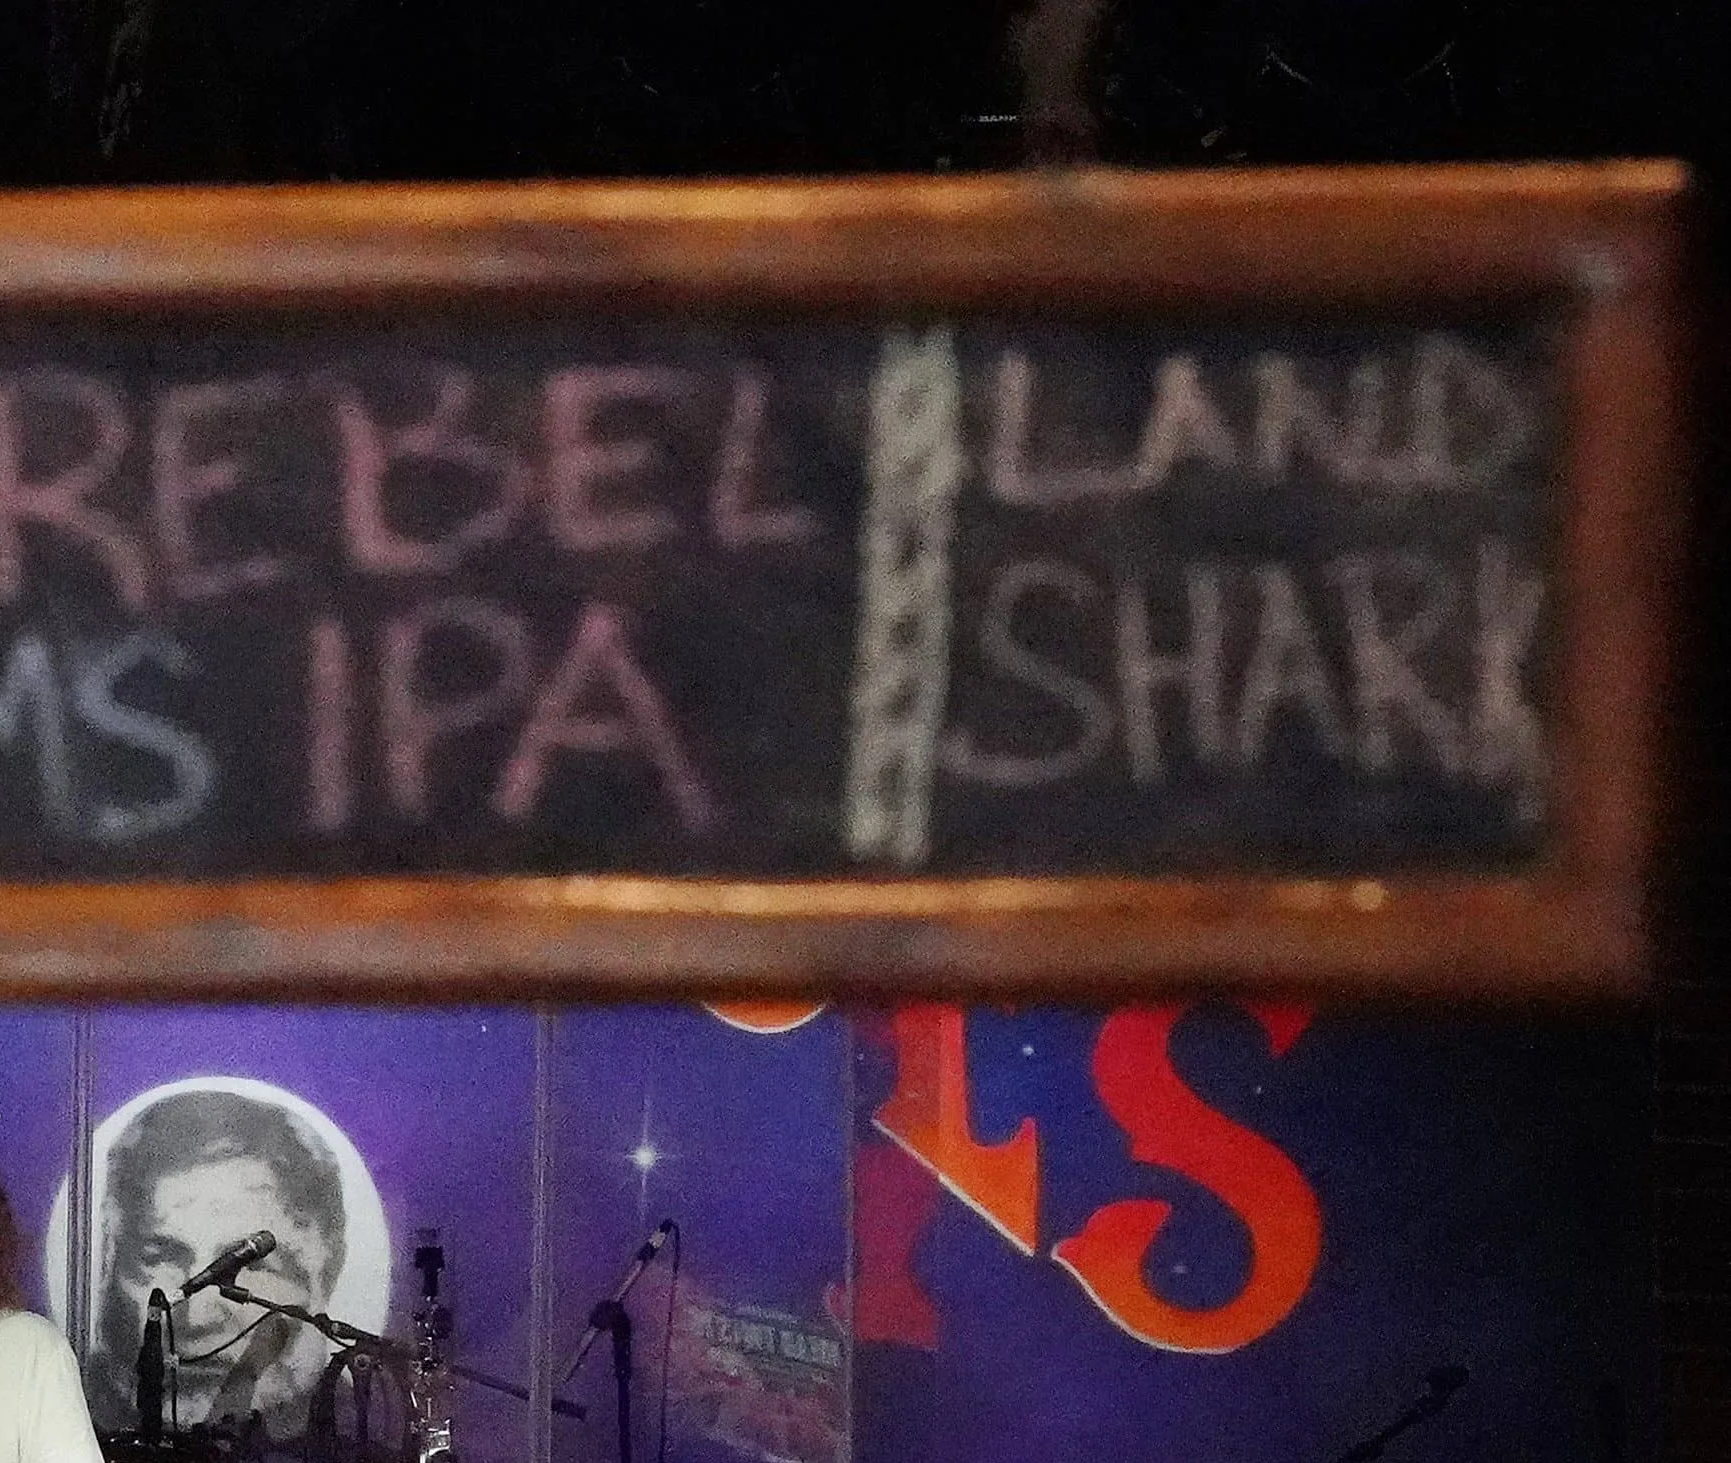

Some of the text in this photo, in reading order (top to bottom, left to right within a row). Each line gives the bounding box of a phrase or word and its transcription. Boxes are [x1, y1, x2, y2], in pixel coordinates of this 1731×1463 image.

[992, 335, 1540, 502] LAND
[300, 596, 728, 836] IPA
[937, 535, 1549, 822] SHARK
